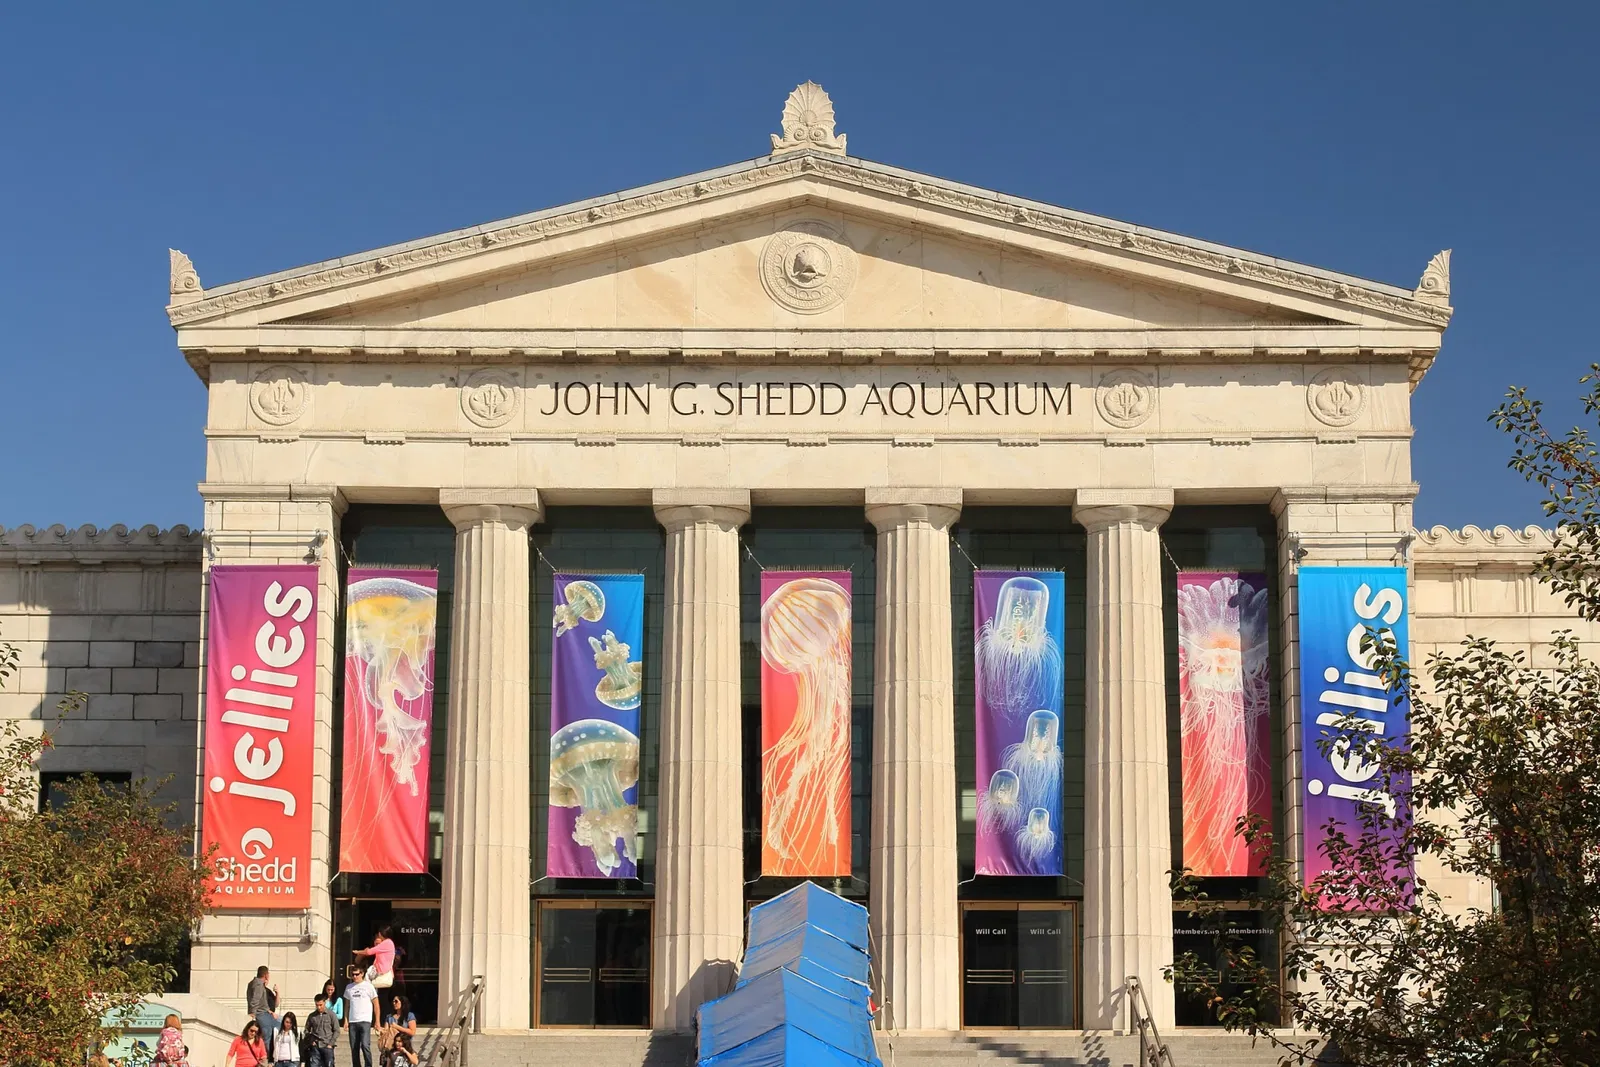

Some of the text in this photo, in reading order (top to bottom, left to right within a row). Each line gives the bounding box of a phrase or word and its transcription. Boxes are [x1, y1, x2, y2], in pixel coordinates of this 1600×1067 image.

[540, 382, 1073, 418] JOHN G. SHEDD AQUARIUM
[209, 580, 313, 817] jellies
[214, 856, 297, 883] Shedd
[215, 885, 295, 895] AQUARIUM
[417, 927, 435, 935] Only
